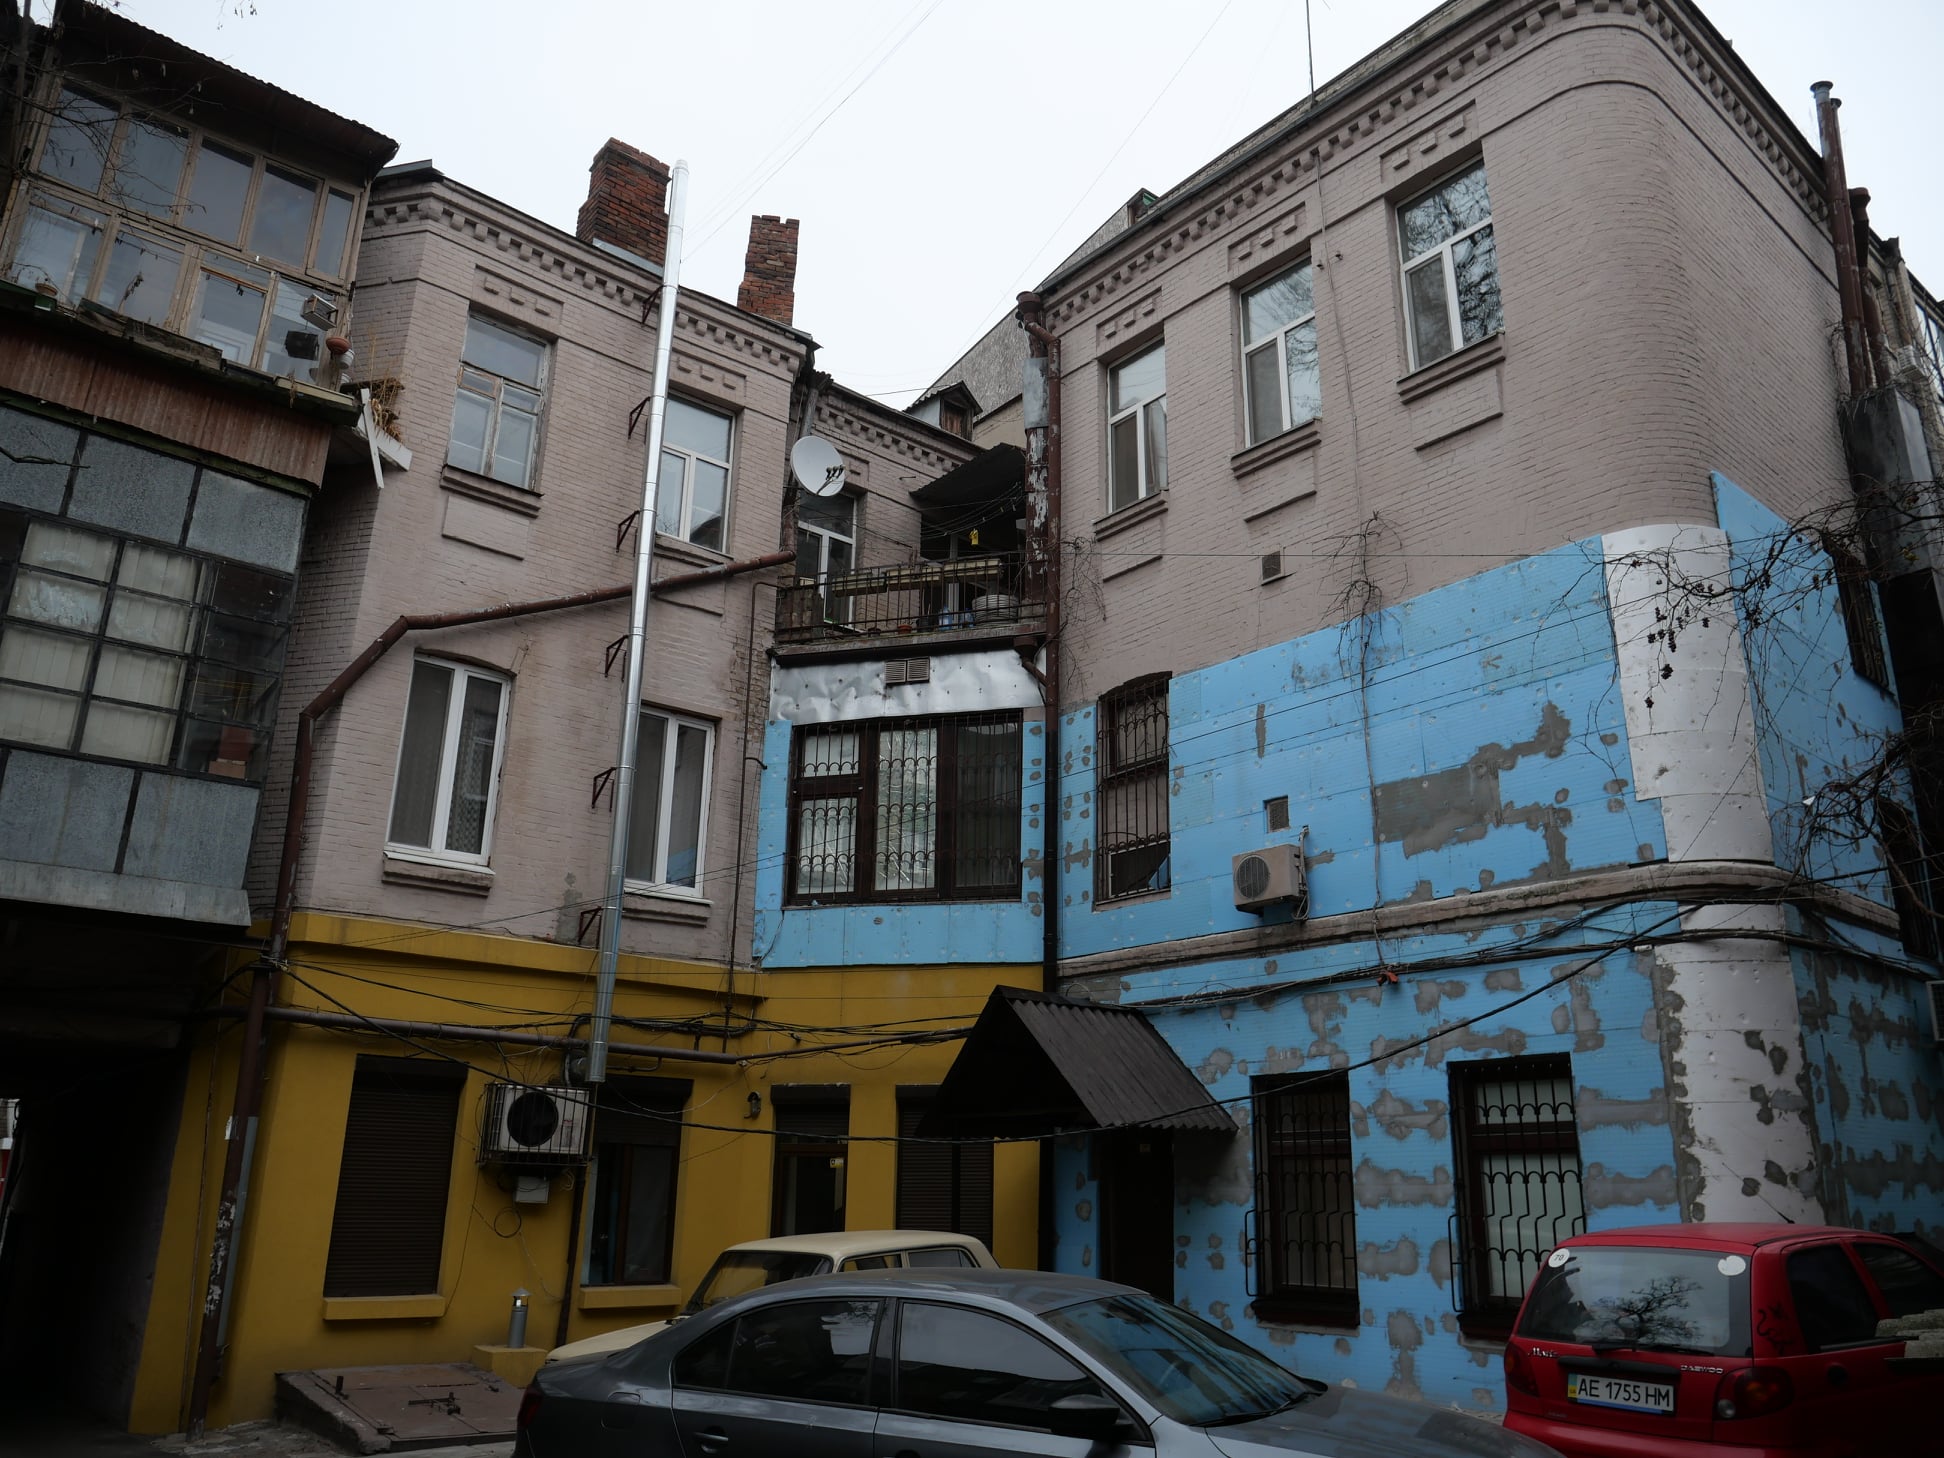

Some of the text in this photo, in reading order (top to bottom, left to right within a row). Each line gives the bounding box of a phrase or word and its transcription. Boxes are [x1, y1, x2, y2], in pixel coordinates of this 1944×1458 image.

[1680, 1364, 1724, 1374] DAEWOO
[1578, 1378, 1670, 1407] AE 1755 HM
